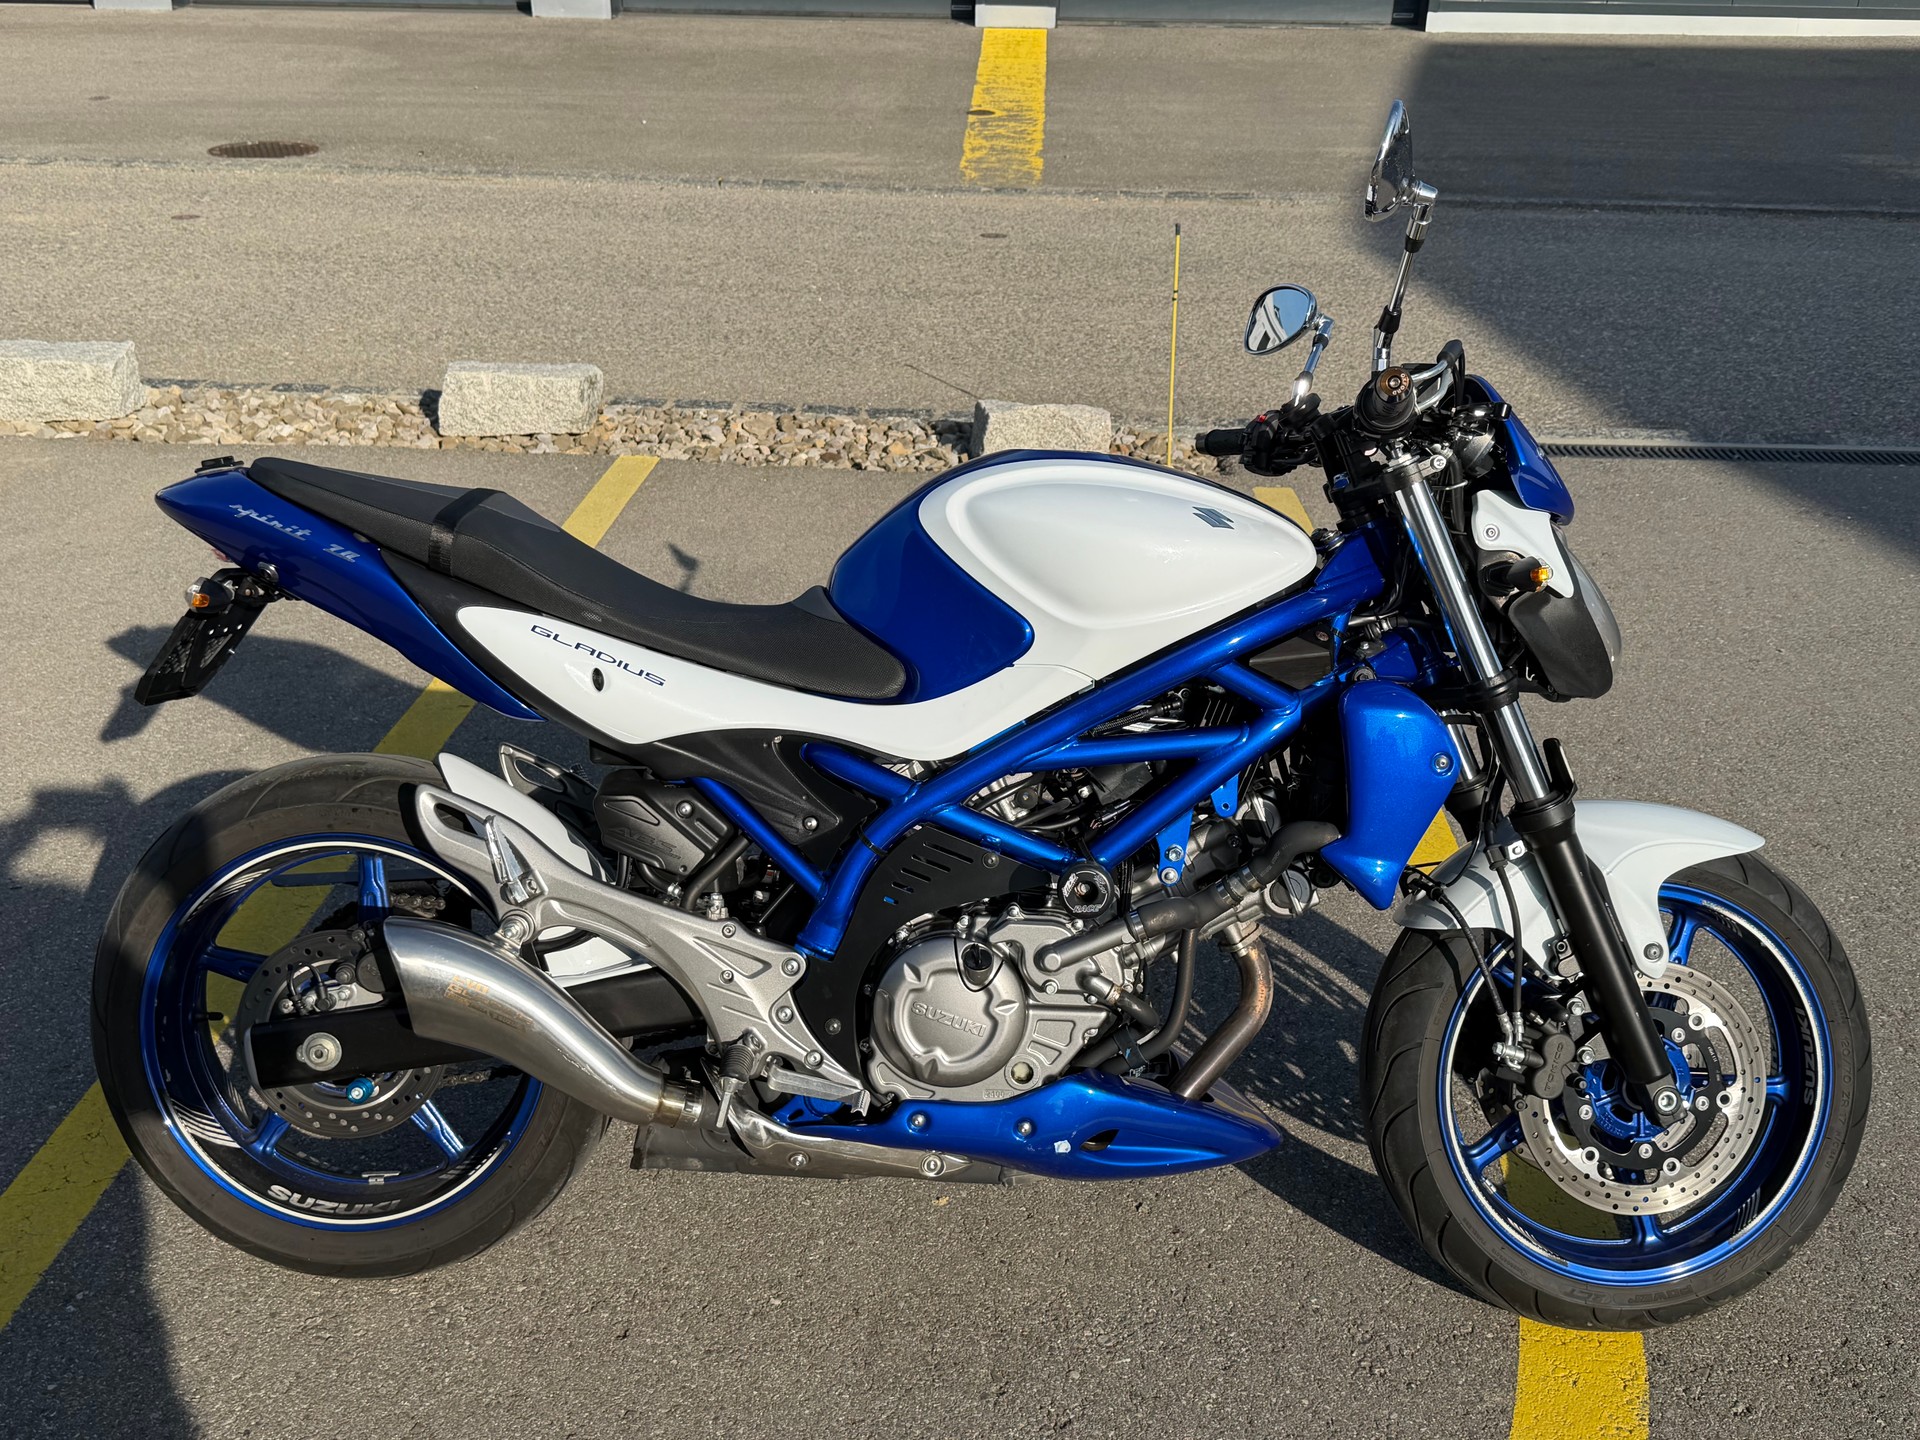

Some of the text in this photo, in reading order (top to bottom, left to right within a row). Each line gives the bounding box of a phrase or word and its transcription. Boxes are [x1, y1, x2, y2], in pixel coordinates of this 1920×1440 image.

[530, 624, 666, 687] GLADIUS
[911, 1001, 987, 1038] SUZUKI
[1543, 1042, 1564, 1092] TOKICO
[1794, 1007, 1815, 1106] SUZUKI
[267, 1184, 400, 1215] SUZUKI
